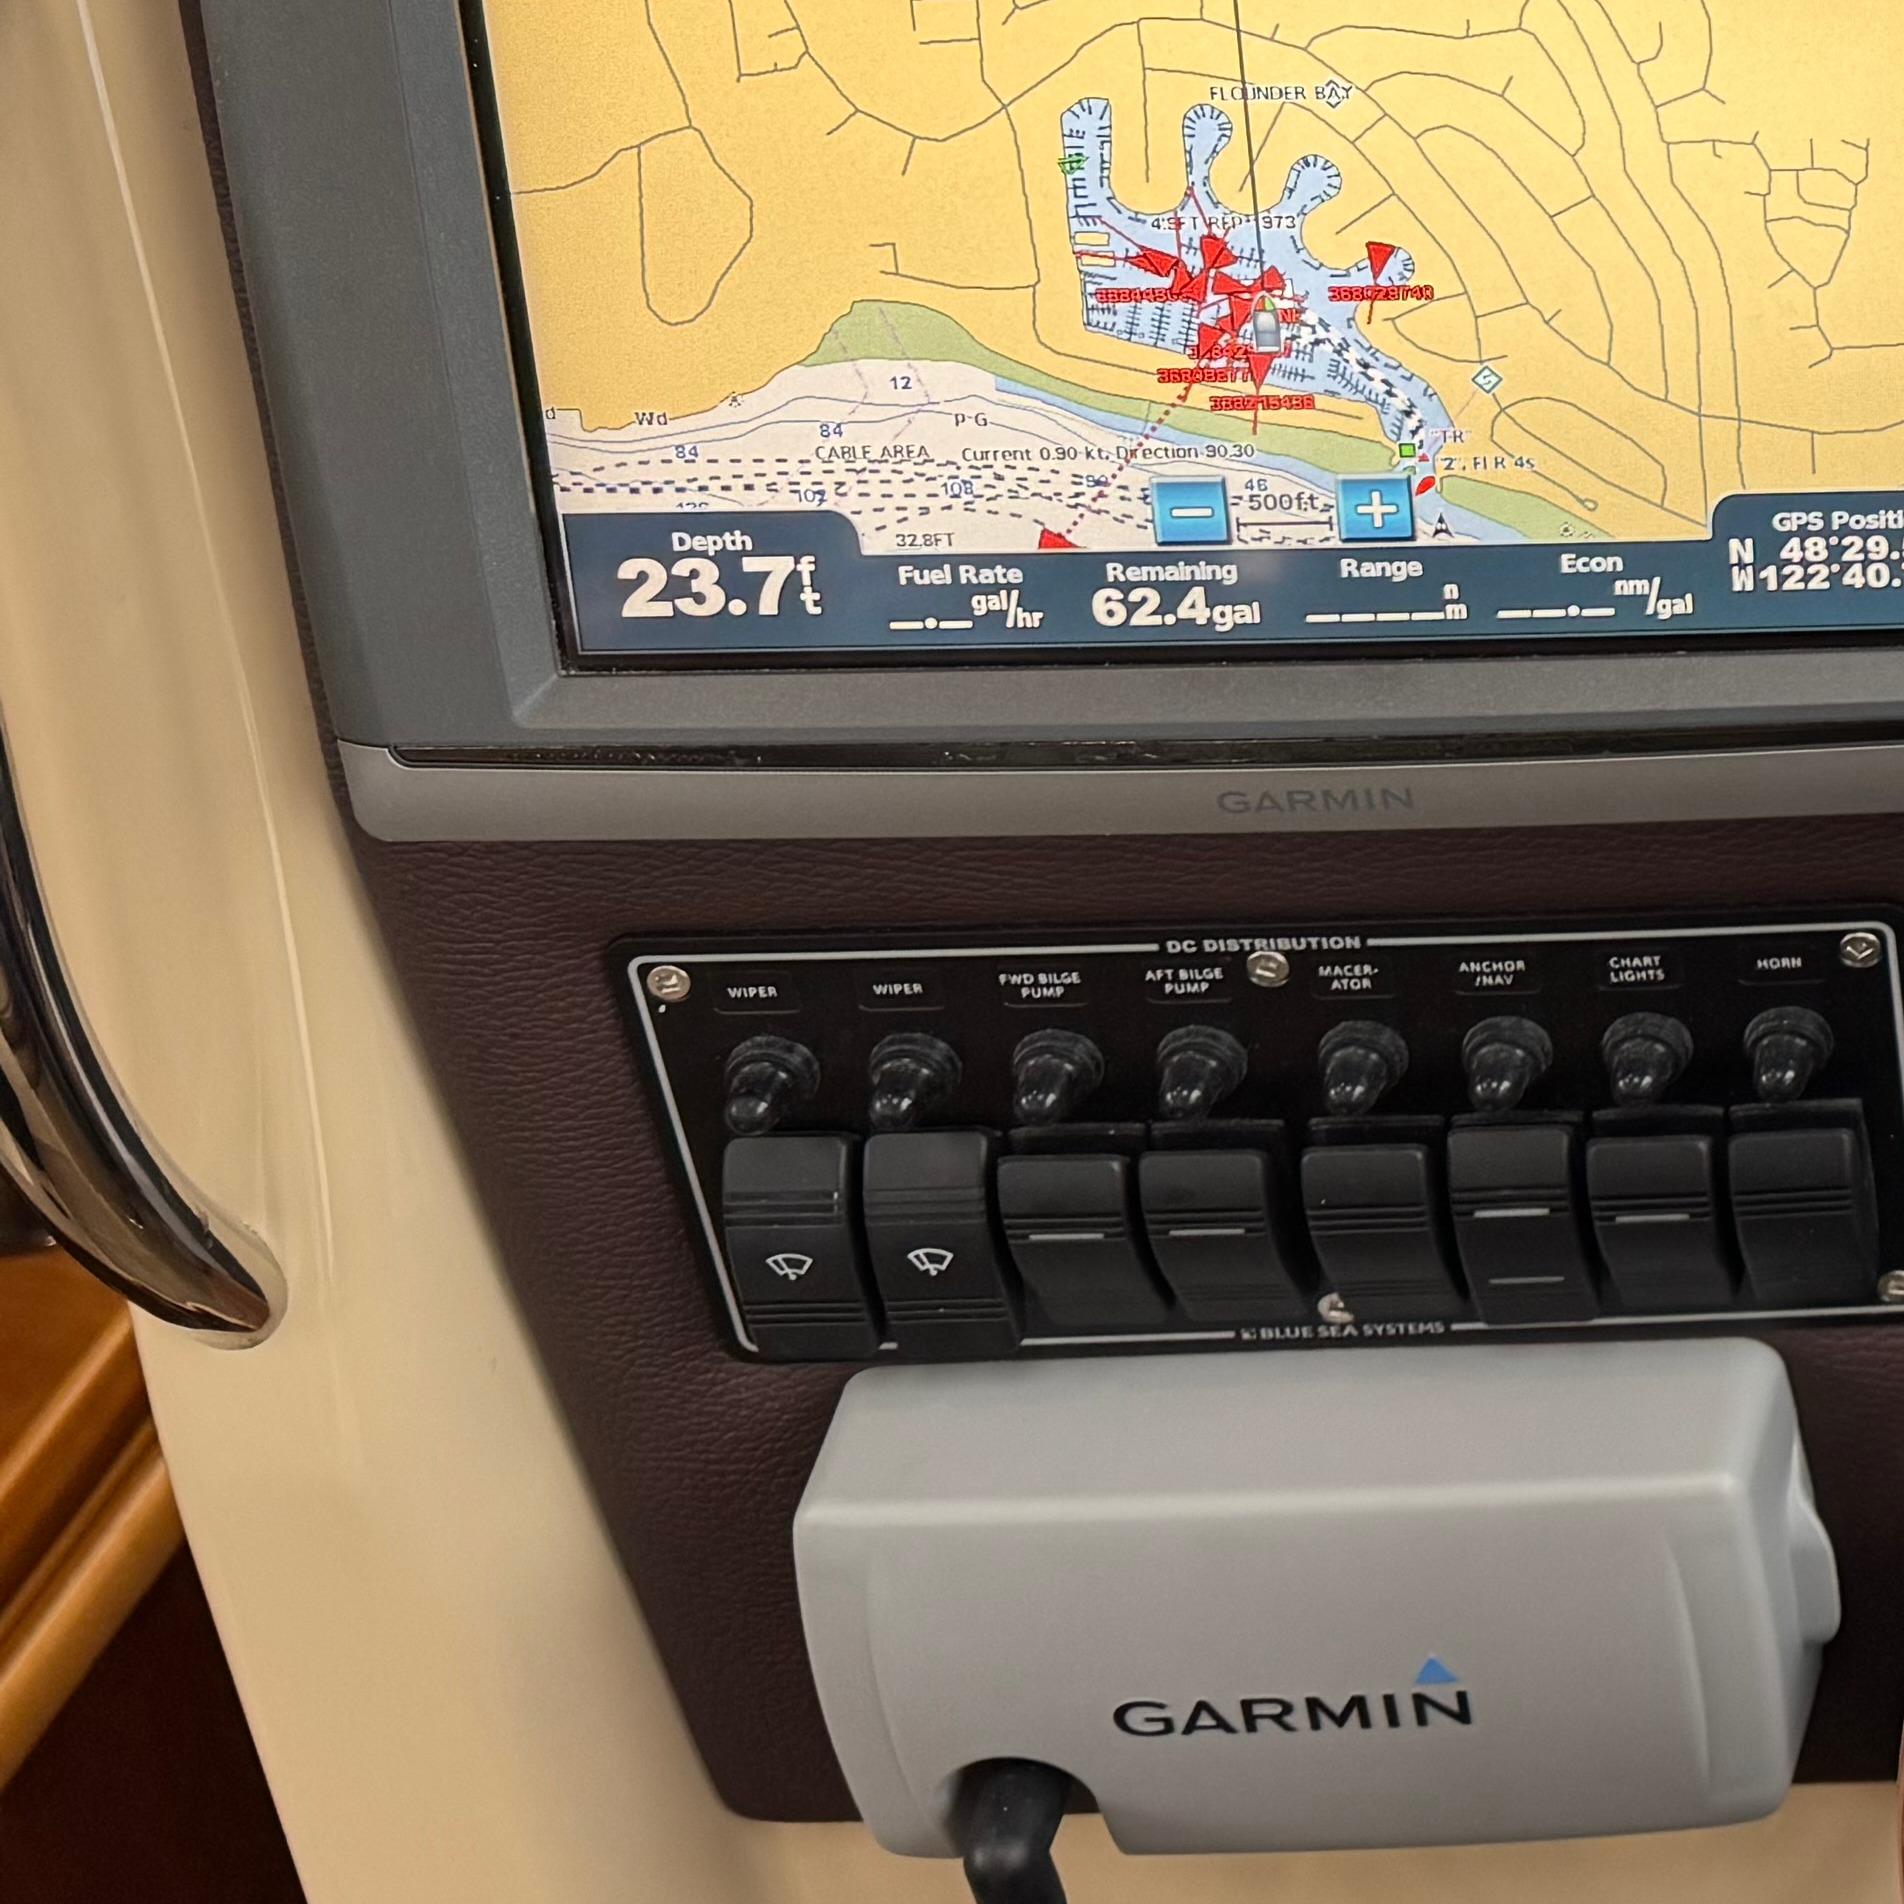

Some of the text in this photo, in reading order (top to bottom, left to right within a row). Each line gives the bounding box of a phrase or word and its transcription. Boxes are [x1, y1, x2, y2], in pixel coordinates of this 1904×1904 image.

[1210, 86, 1306, 101] FLOUNDER
[890, 375, 912, 390] 12
[634, 412, 668, 426] Wd
[819, 424, 843, 438] 84
[675, 446, 698, 458] 84
[815, 445, 930, 461] CABLE AREA
[962, 447, 1031, 462] Current
[1040, 447, 1077, 461] 0.90
[1116, 446, 1199, 461] Direction
[1205, 445, 1255, 459] 90.30
[1772, 511, 1824, 532] GPS
[671, 532, 753, 554] Depth
[896, 533, 953, 548] 32.8FT
[1728, 537, 1755, 565] N
[1340, 558, 1422, 582] Range
[1560, 553, 1623, 573] Econ
[898, 565, 1023, 585] Fuel Rate
[1106, 562, 1238, 586] Remaining
[1217, 787, 1415, 813] GARMIN
[1166, 935, 1361, 955] DC DISTRIBUTION
[1458, 959, 1526, 973] ANCHOR
[1609, 955, 1661, 970] CHART
[1756, 957, 1802, 969] HORN
[999, 970, 1081, 987] FWD BILGE
[1144, 966, 1224, 984] AFT BILGE
[1318, 964, 1379, 978] MACER-
[1609, 968, 1665, 983] LIGHTS
[1164, 981, 1210, 995] PUMP
[1330, 977, 1373, 991] ATOR
[1474, 973, 1514, 988] /NAV
[727, 986, 778, 1000] WIPER
[873, 982, 924, 997] WIPER
[1020, 984, 1065, 999] PUMP
[1260, 1321, 1445, 1339] BLUE SEA SYSTEMS
[1112, 1690, 1473, 1737] GARMIN
